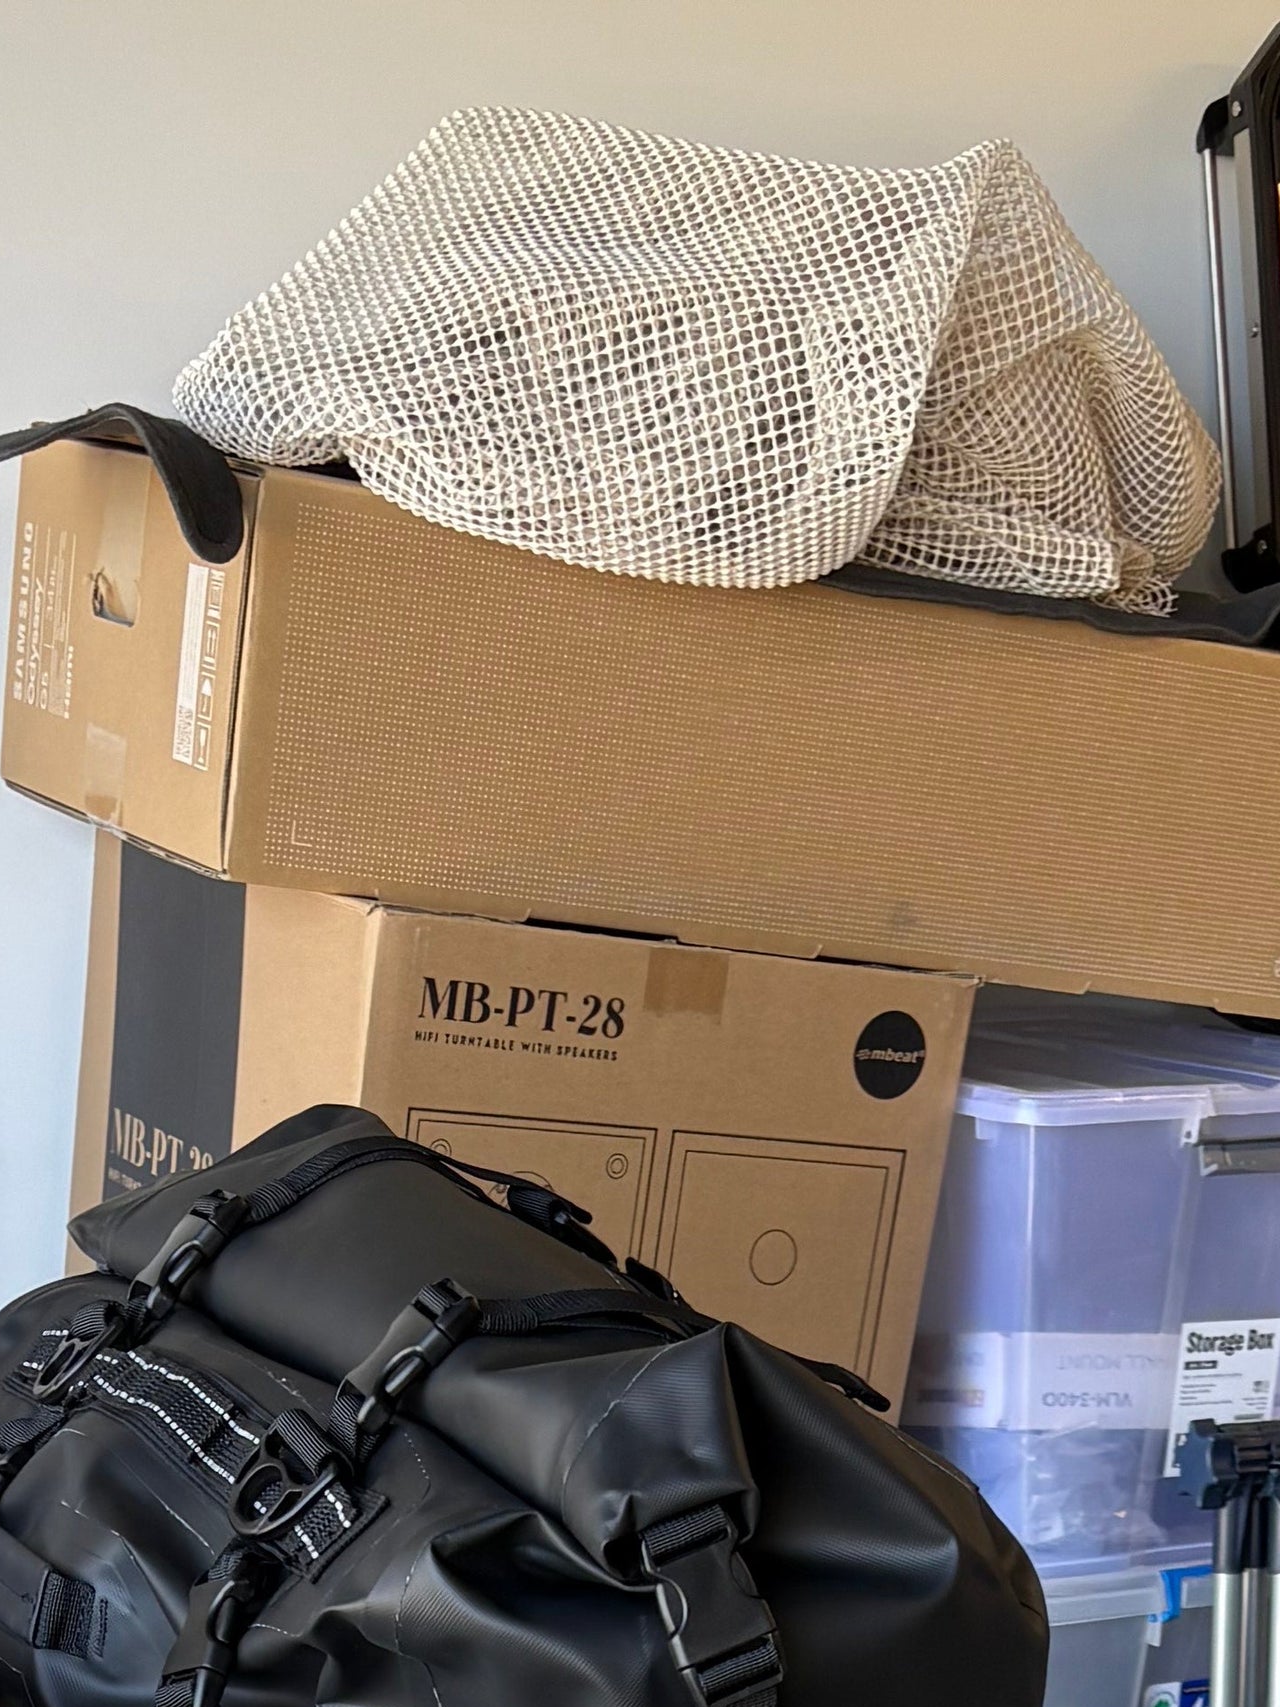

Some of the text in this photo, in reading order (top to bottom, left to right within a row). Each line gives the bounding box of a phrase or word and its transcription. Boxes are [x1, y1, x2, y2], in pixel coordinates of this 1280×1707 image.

[13, 522, 33, 700] SAMSUNG
[26, 578, 46, 705] Odyssey
[418, 976, 625, 1039] MB-PT-28
[414, 1030, 619, 1062] HIFI TURNTABLE WITH SPEAKERS
[1186, 1329, 1276, 1356] Storage Box
